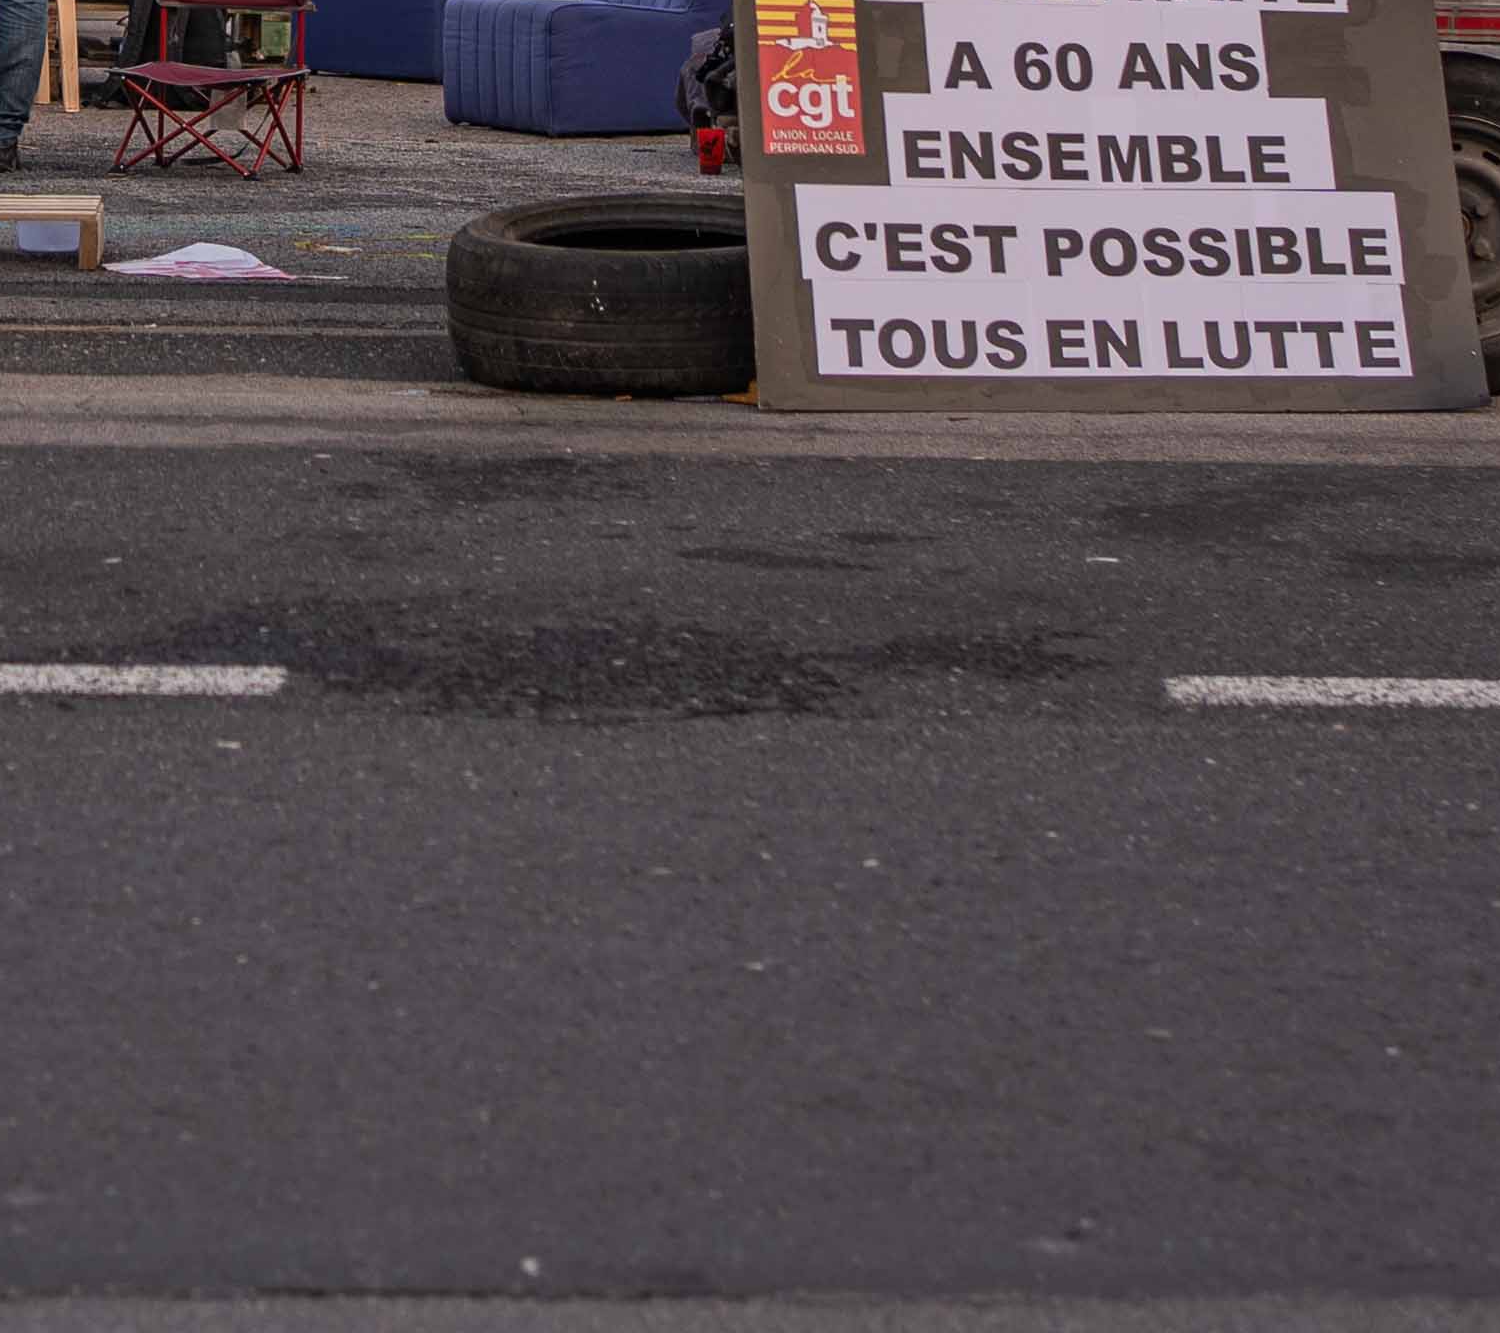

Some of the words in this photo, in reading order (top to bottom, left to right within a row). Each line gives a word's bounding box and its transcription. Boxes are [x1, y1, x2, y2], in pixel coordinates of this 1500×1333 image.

[944, 41, 993, 90] A
[1013, 42, 1093, 92] 60
[1117, 41, 1261, 92] ANS
[767, 74, 855, 129] cgt
[769, 142, 834, 154] PERPIGNAN
[835, 143, 859, 155] SUD
[772, 129, 807, 141] UNION
[812, 130, 853, 142] LOCALE
[901, 129, 1291, 184] ENSEMBLE
[815, 221, 1017, 275] C'EST
[1042, 226, 1393, 278] POSSIBLE
[830, 318, 1028, 370] TOUS
[1044, 319, 1143, 369] EN
[1163, 319, 1401, 369] LUTTE
